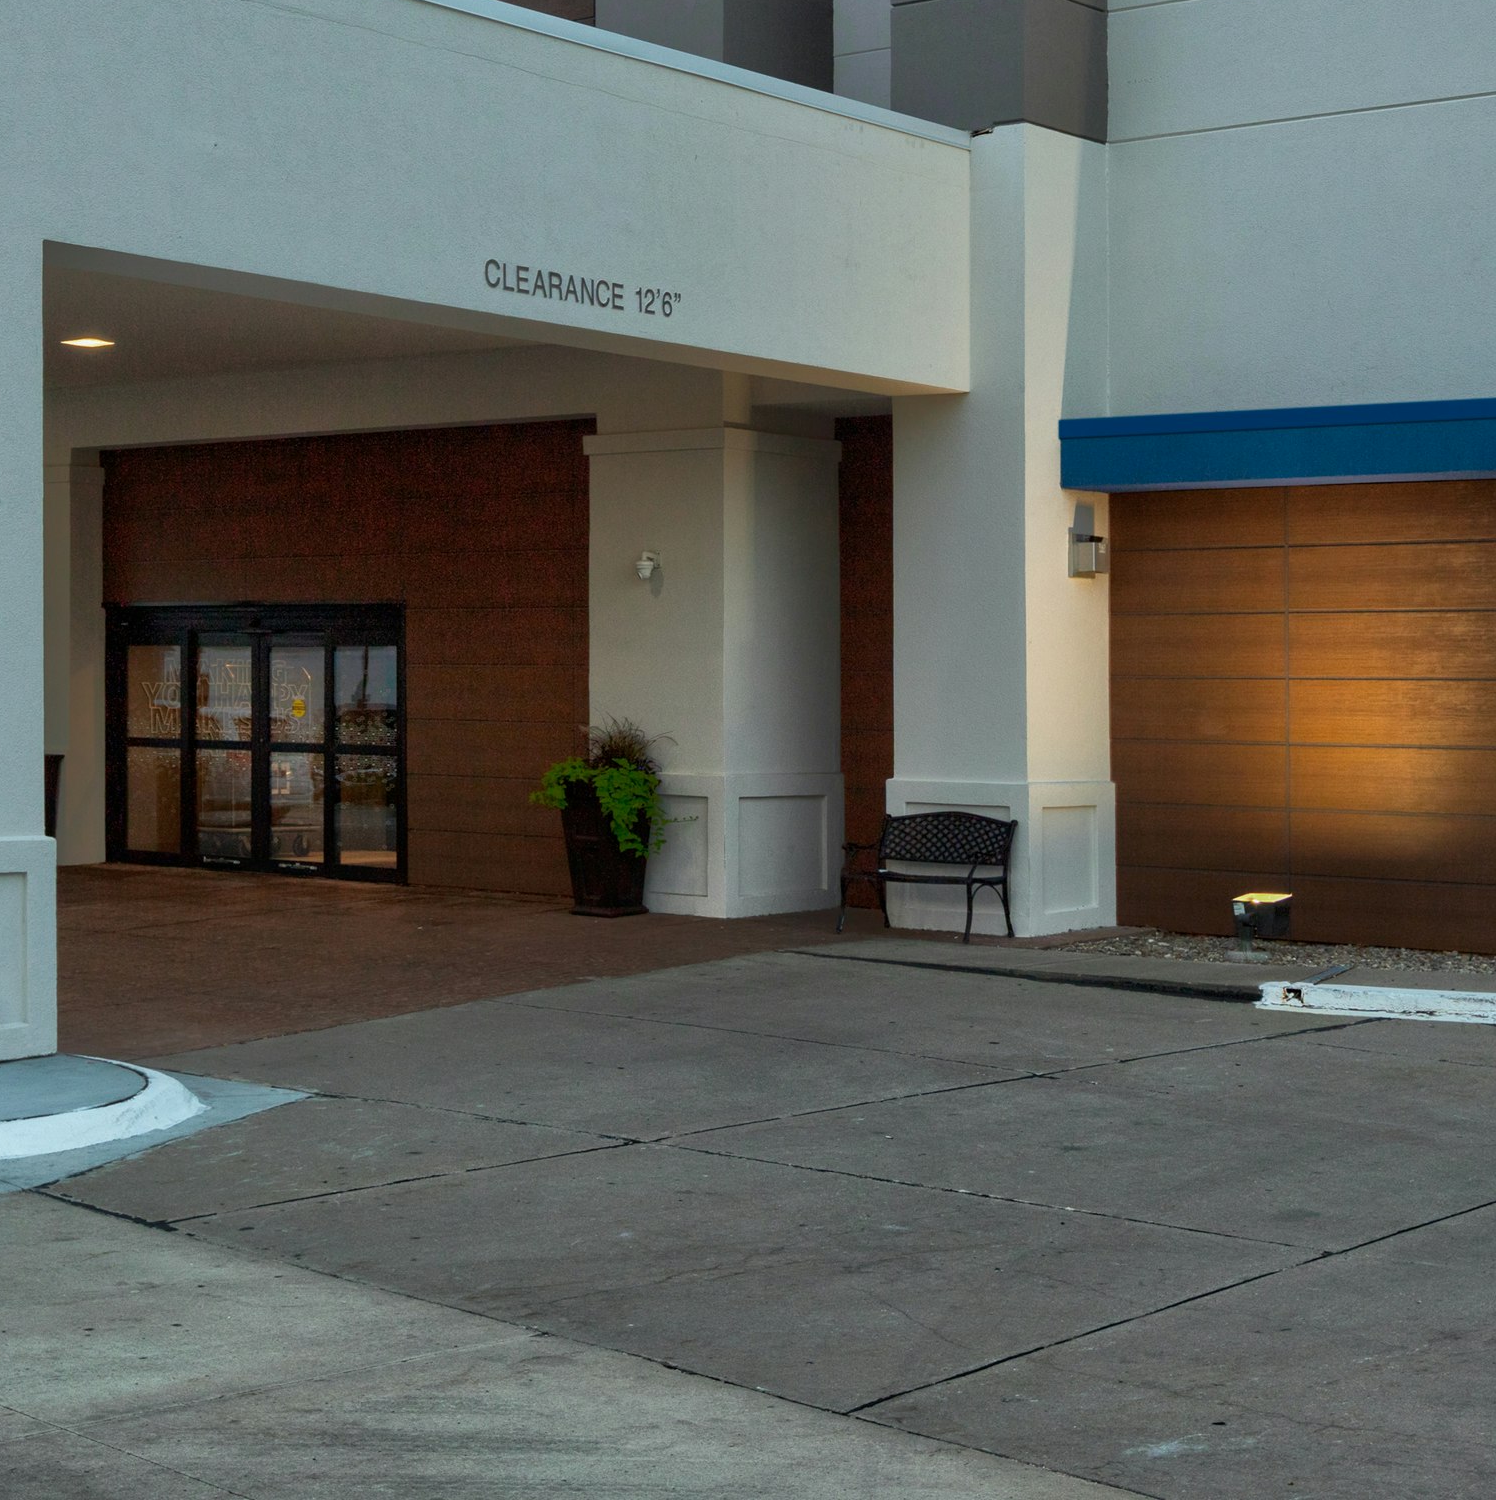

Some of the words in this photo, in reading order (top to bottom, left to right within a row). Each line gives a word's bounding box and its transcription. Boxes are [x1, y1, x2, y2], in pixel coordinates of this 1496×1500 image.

[485, 258, 624, 310] CLEARANCE
[164, 659, 288, 687] MAKIG
[215, 683, 308, 710] HAPY
